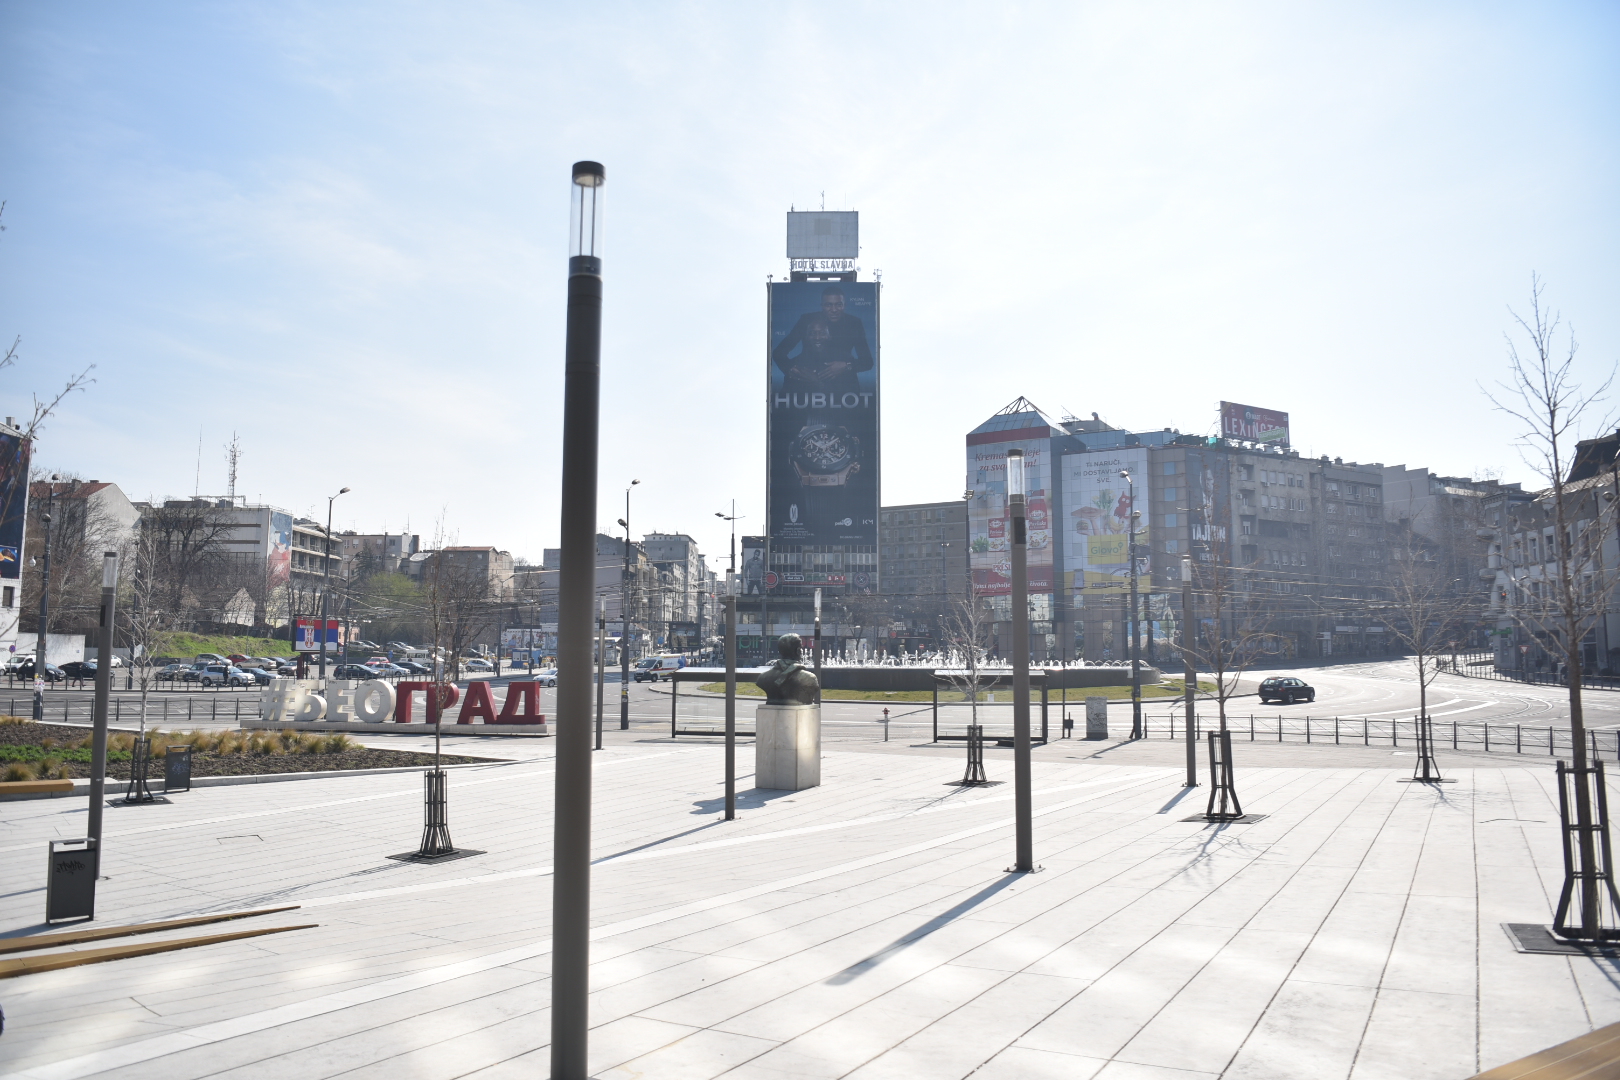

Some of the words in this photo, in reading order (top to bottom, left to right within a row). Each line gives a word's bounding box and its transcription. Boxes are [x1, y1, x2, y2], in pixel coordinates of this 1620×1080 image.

[792, 260, 817, 269] HOTEL
[775, 392, 873, 409] HUBLOT
[1091, 546, 1119, 555] Glovo
[259, 679, 546, 725] #БЕОГРАД
